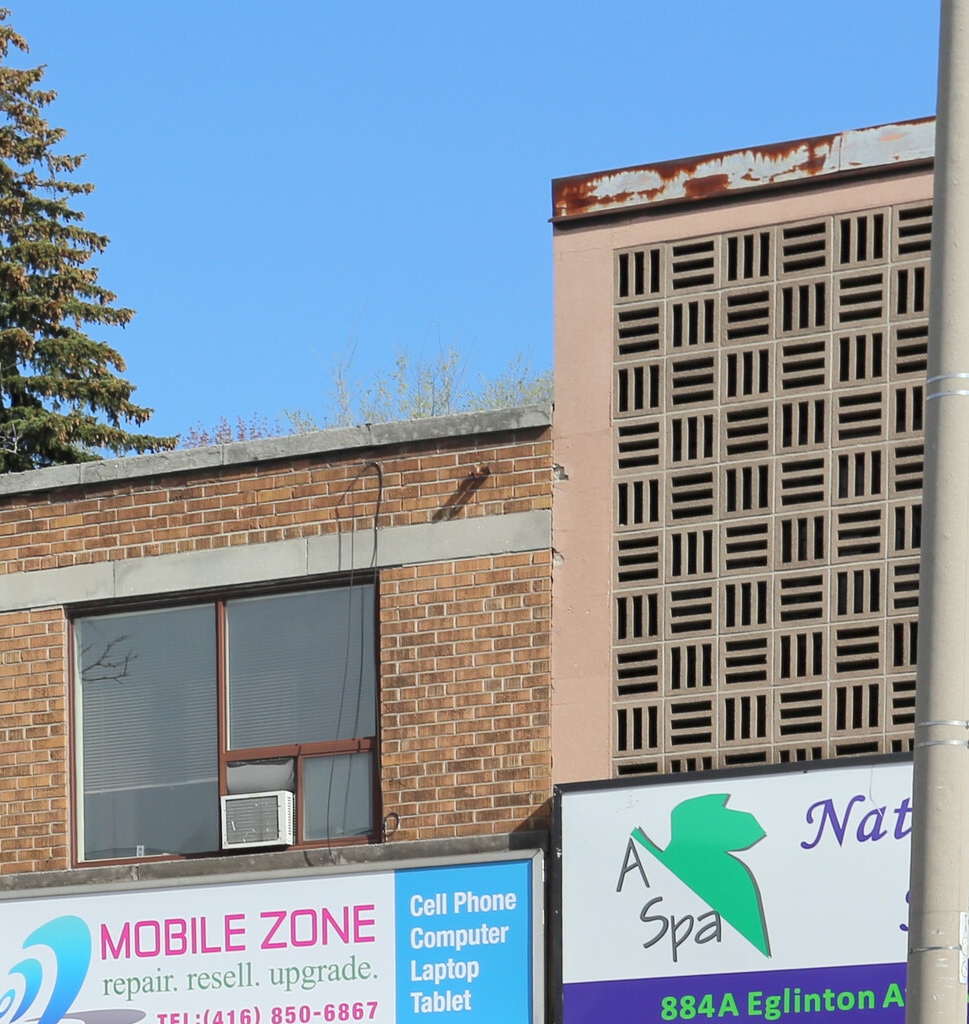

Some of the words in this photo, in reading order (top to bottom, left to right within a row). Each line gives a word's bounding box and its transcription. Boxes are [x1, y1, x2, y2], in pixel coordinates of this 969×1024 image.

[616, 837, 650, 893] A
[410, 893, 447, 917] Cell
[454, 890, 517, 914] Phone
[101, 914, 245, 960] MOBILE
[260, 904, 376, 949] ZONE
[410, 923, 509, 953] Computer
[640, 897, 722, 963] Spa
[102, 967, 178, 1000] repair.
[187, 961, 260, 992] resell.
[270, 954, 379, 989] upgrade.
[410, 958, 480, 987] Laptop
[410, 989, 472, 1014] Tablet
[747, 986, 876, 1021] Eglinton
[883, 982, 907, 1008] A
